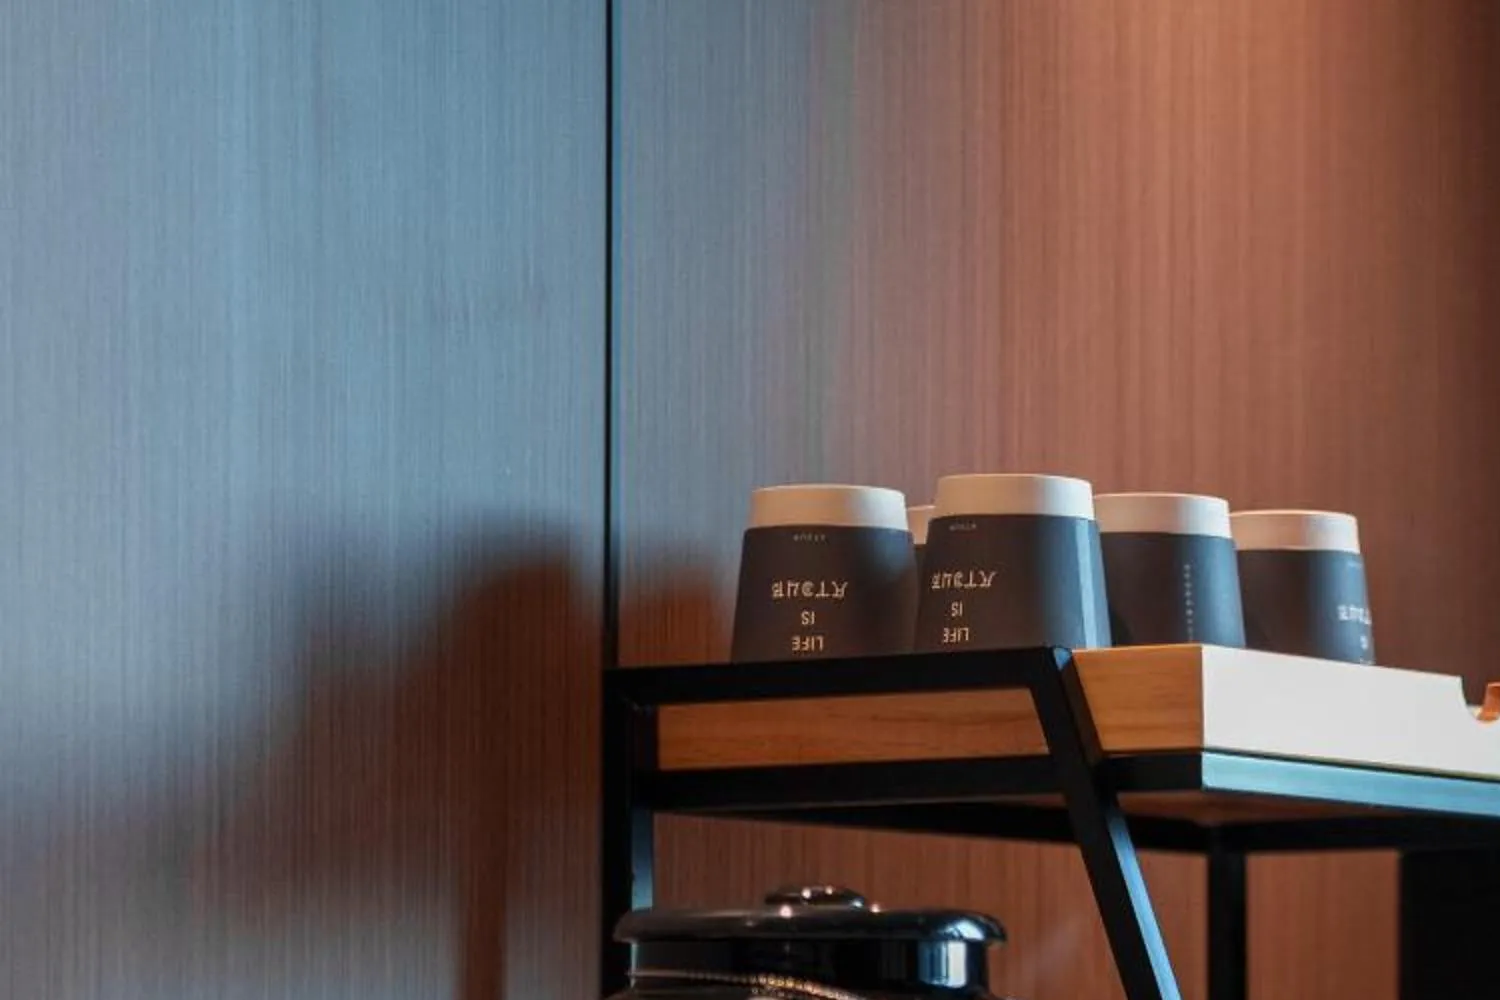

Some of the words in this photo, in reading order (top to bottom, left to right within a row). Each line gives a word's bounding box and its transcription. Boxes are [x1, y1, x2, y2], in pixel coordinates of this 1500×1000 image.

[950, 600, 964, 618] IS
[800, 611, 815, 626] IS
[791, 635, 824, 652] LIFE
[943, 627, 969, 645] LIFE
